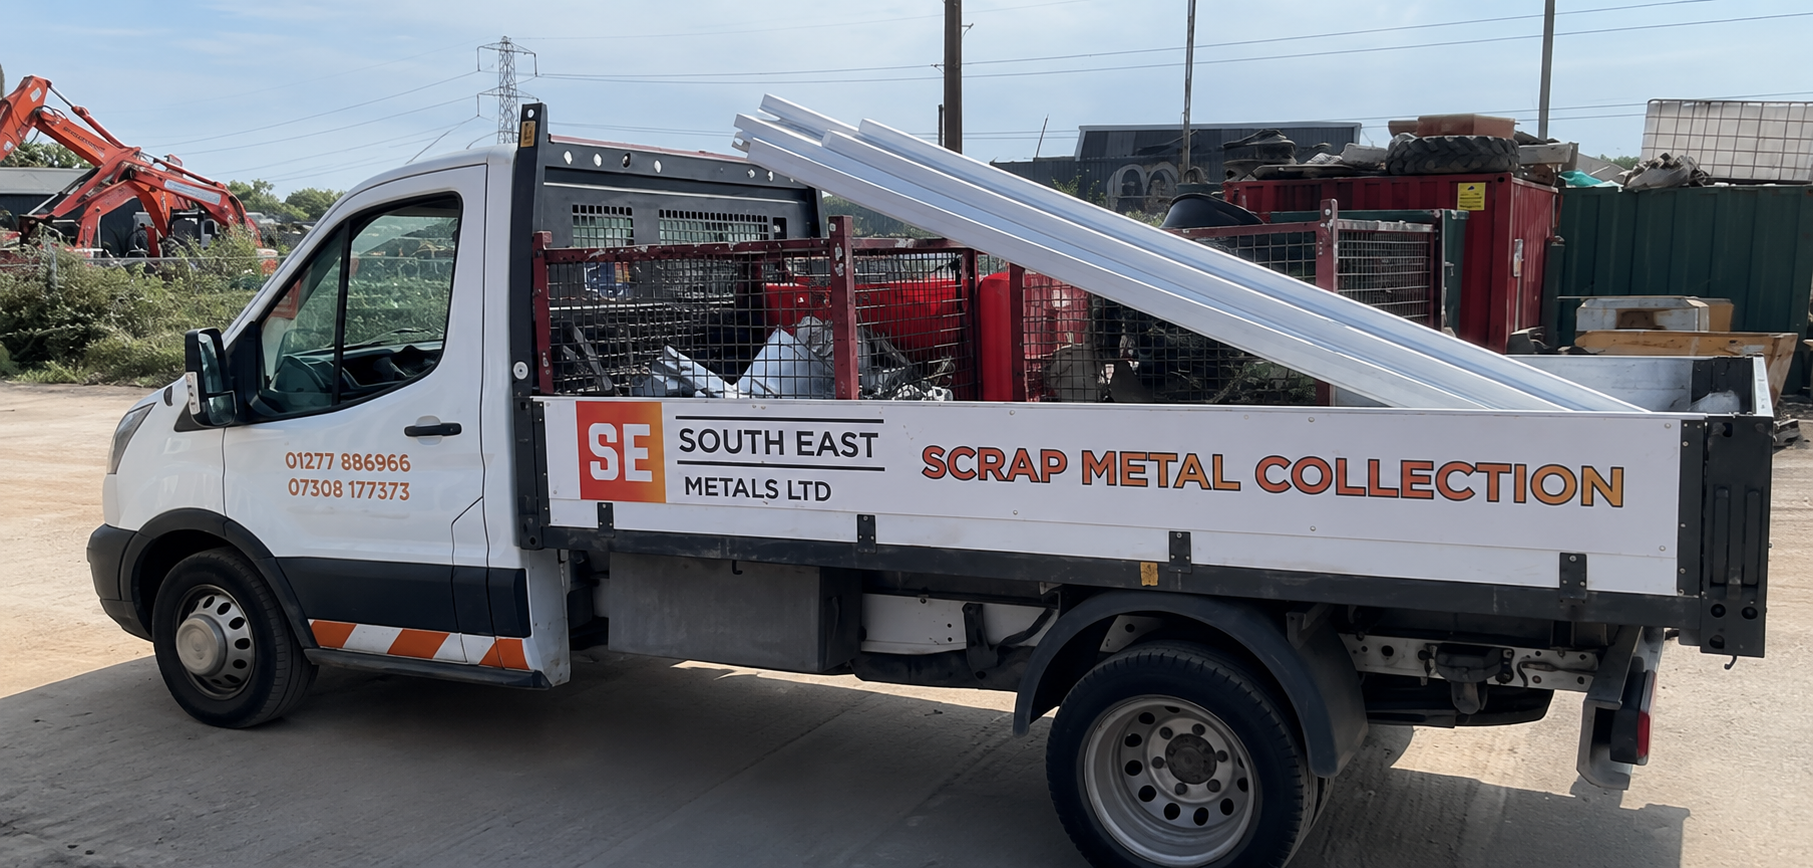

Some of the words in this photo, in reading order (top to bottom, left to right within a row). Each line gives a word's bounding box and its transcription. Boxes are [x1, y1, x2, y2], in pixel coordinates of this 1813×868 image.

[588, 422, 653, 483] SE
[678, 427, 785, 456] SOUTH
[796, 430, 879, 458] EAST
[285, 451, 335, 470] 01277
[341, 453, 411, 472] 886966
[288, 478, 343, 498] 07308
[348, 480, 410, 501] 177373
[684, 476, 779, 500] METALS
[787, 479, 832, 502] LTD
[921, 444, 1069, 484] SCRAP
[1081, 449, 1242, 492] METAL
[1254, 454, 1625, 509] COLLECTION
